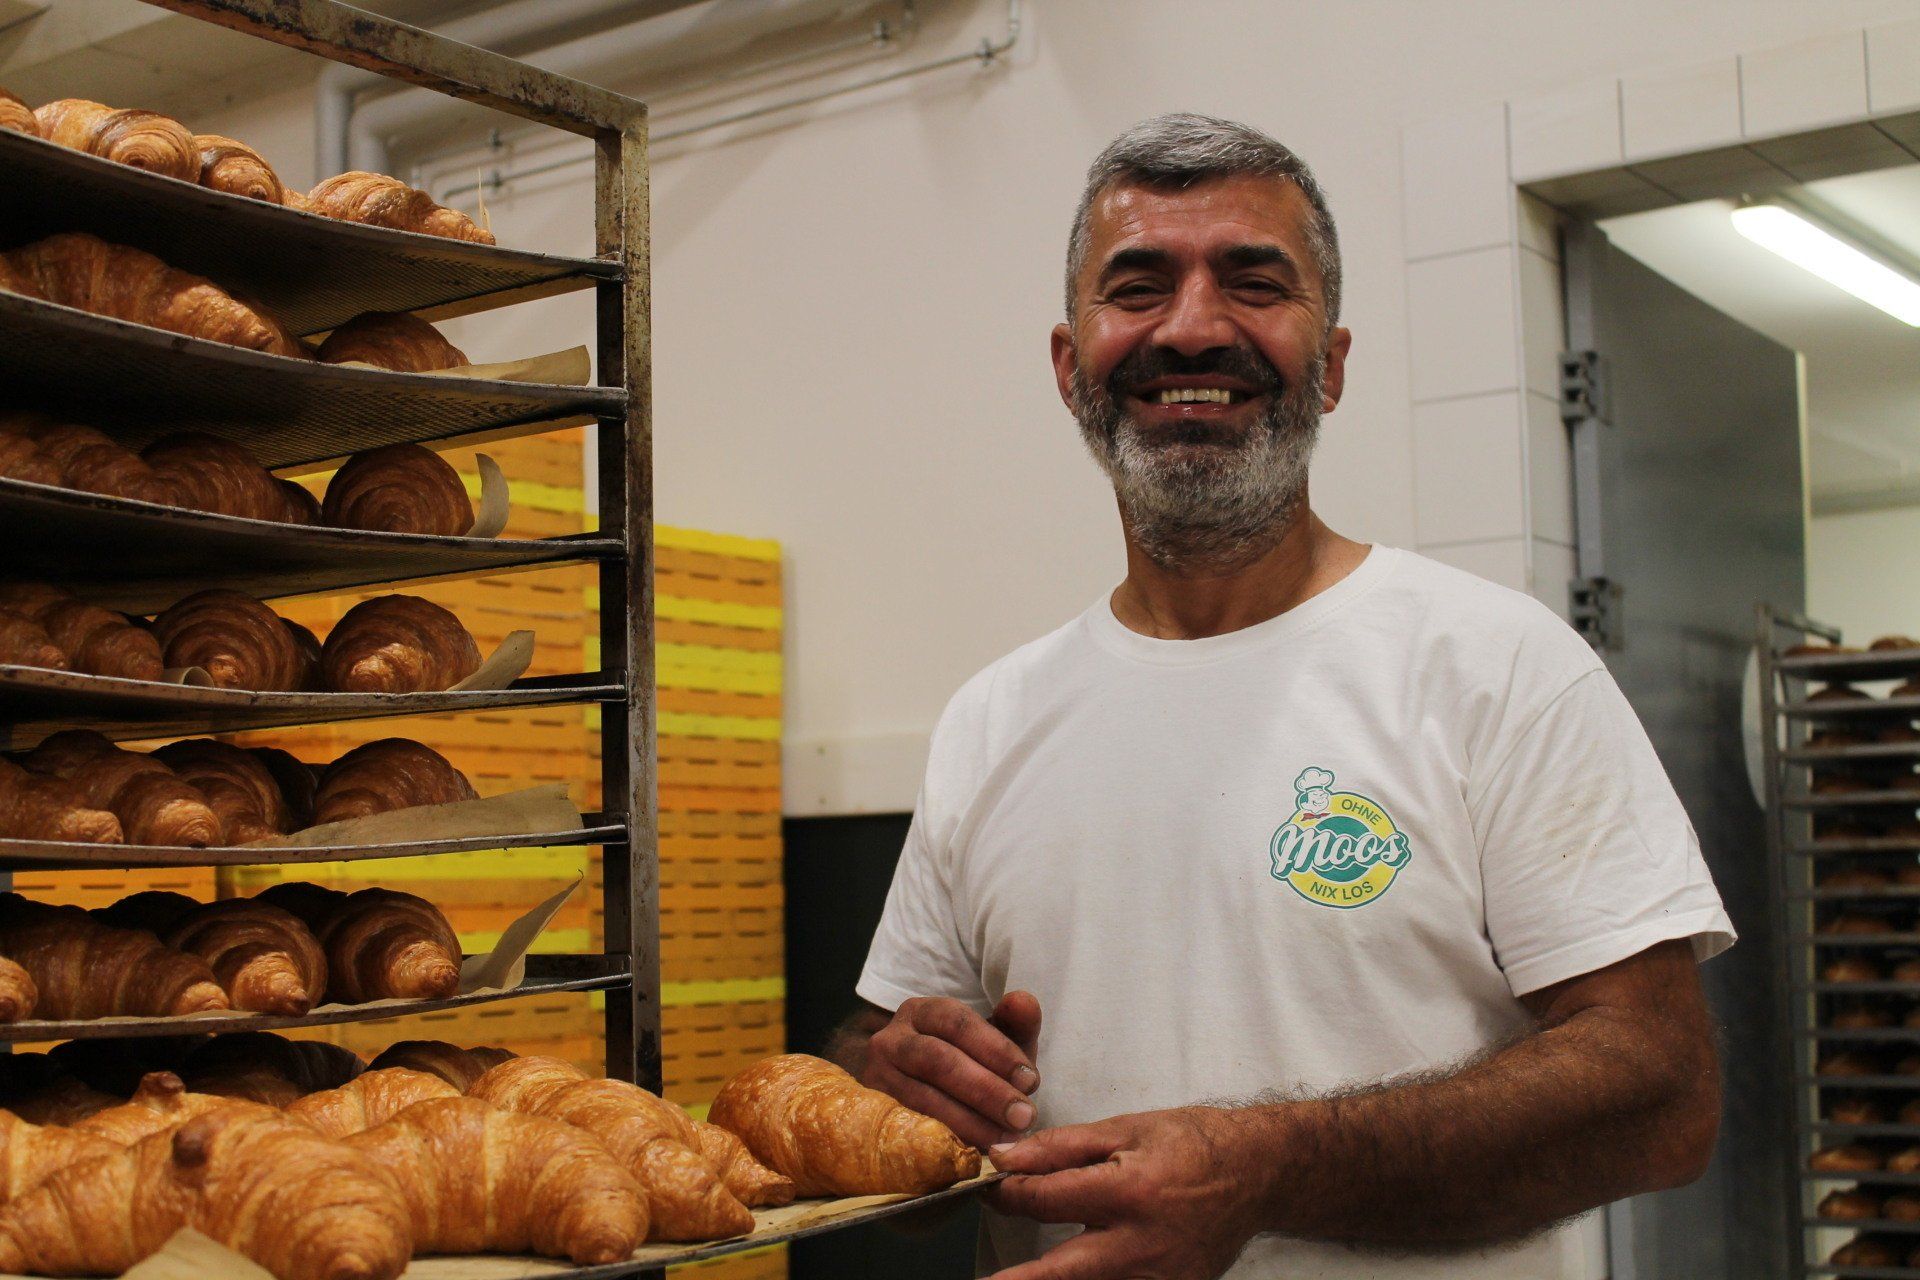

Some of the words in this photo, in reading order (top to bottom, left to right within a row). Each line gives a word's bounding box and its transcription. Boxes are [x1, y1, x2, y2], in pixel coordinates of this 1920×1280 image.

[1341, 798, 1382, 826] OHNE
[1273, 823, 1405, 875] Moos
[1310, 881, 1337, 899] NIX
[1342, 881, 1374, 900] LOS
